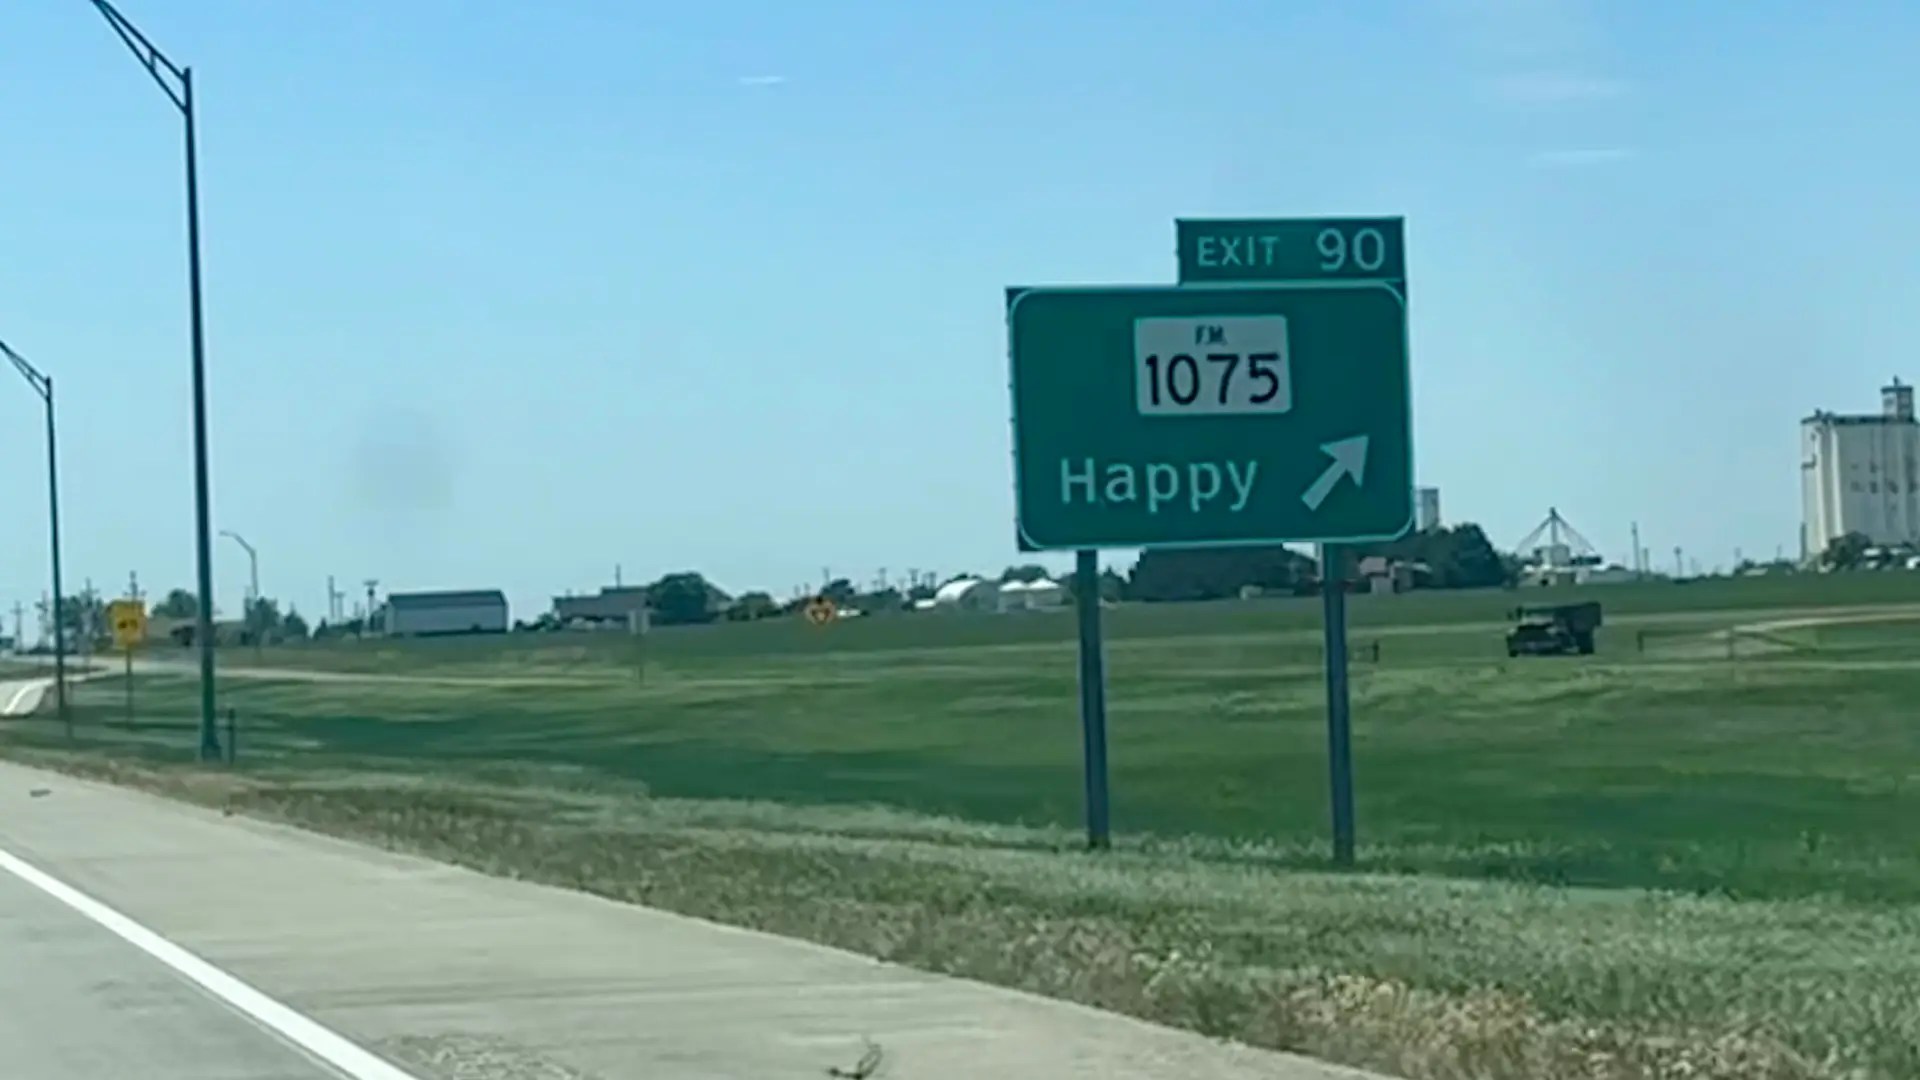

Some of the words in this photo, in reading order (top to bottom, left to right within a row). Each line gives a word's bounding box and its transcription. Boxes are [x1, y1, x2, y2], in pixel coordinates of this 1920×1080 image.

[1197, 236, 1280, 266] EXIT
[1316, 228, 1385, 271] 90
[1145, 353, 1281, 406] 1075
[1060, 457, 1258, 513] Happy
